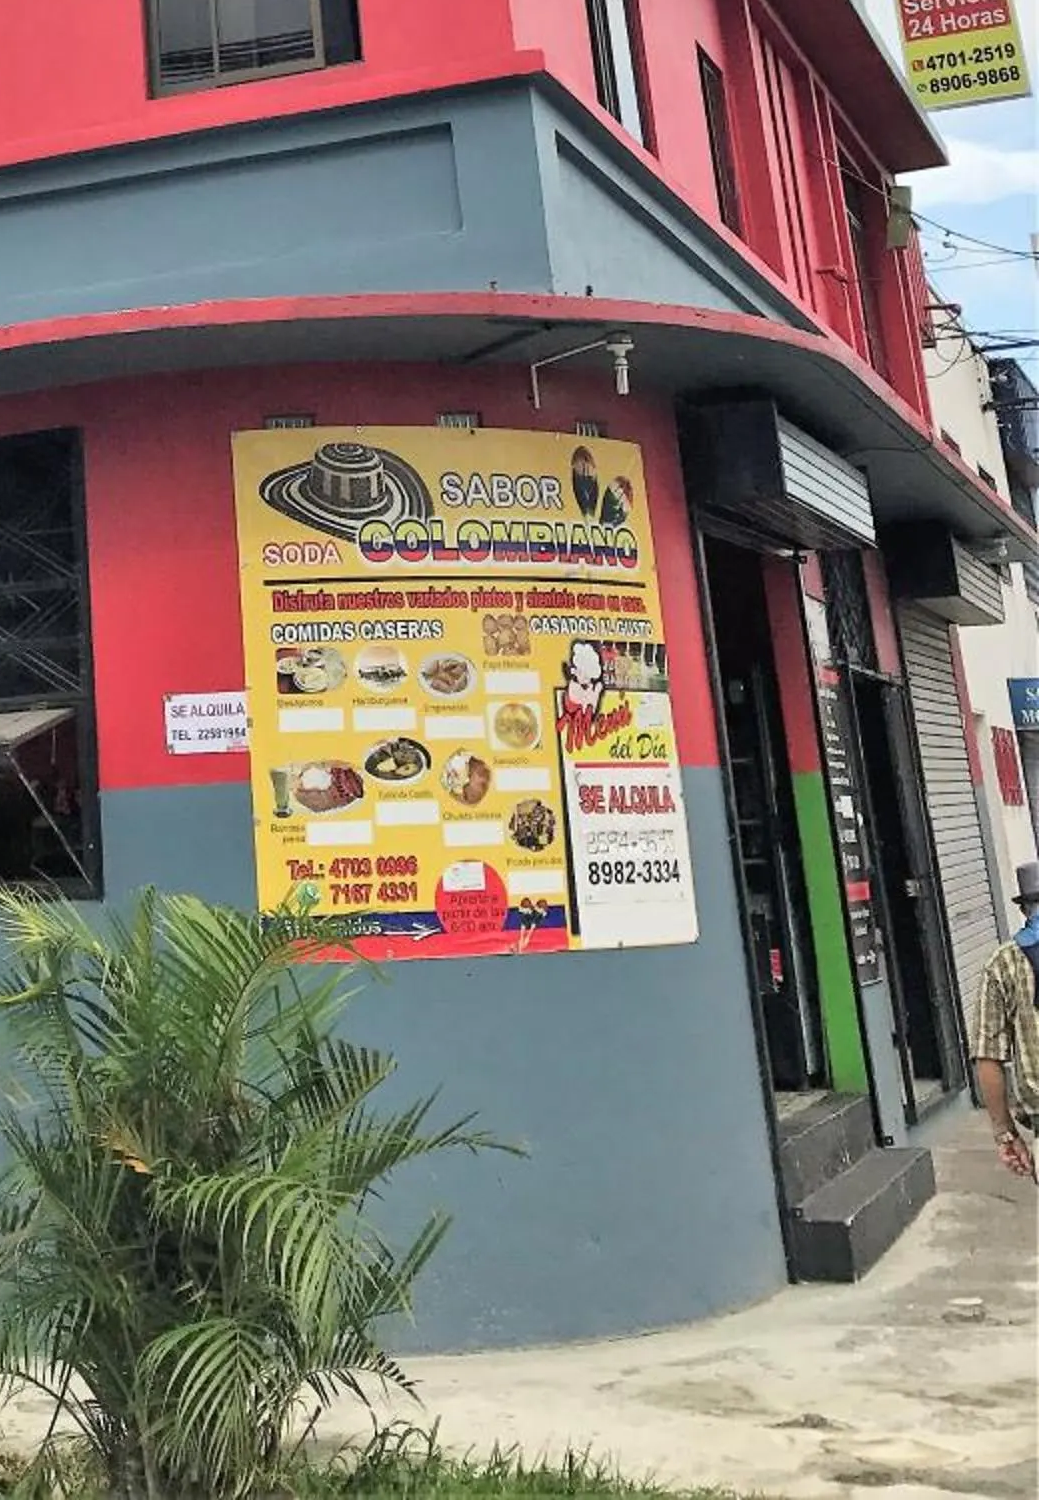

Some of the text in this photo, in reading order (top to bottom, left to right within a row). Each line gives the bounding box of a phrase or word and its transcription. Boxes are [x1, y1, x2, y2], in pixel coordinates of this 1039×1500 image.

[909, 8, 1006, 37] 24 Horas
[926, 42, 1016, 71] 4701-2519
[440, 471, 563, 510] SABOR
[263, 519, 638, 568] SODA COLOMBIANO
[272, 589, 335, 612] Disfruta
[337, 587, 406, 610] nuestros
[407, 586, 469, 609] variados
[514, 591, 523, 612] y
[271, 619, 444, 643] COMIDAS CASERAS
[529, 615, 597, 636] CASADOS
[615, 619, 654, 638] GUSTO
[170, 702, 245, 718] SE ALQUILA
[609, 734, 634, 759] del
[579, 785, 676, 815] SE ALQUILA
[588, 859, 680, 885] 8982-3334
